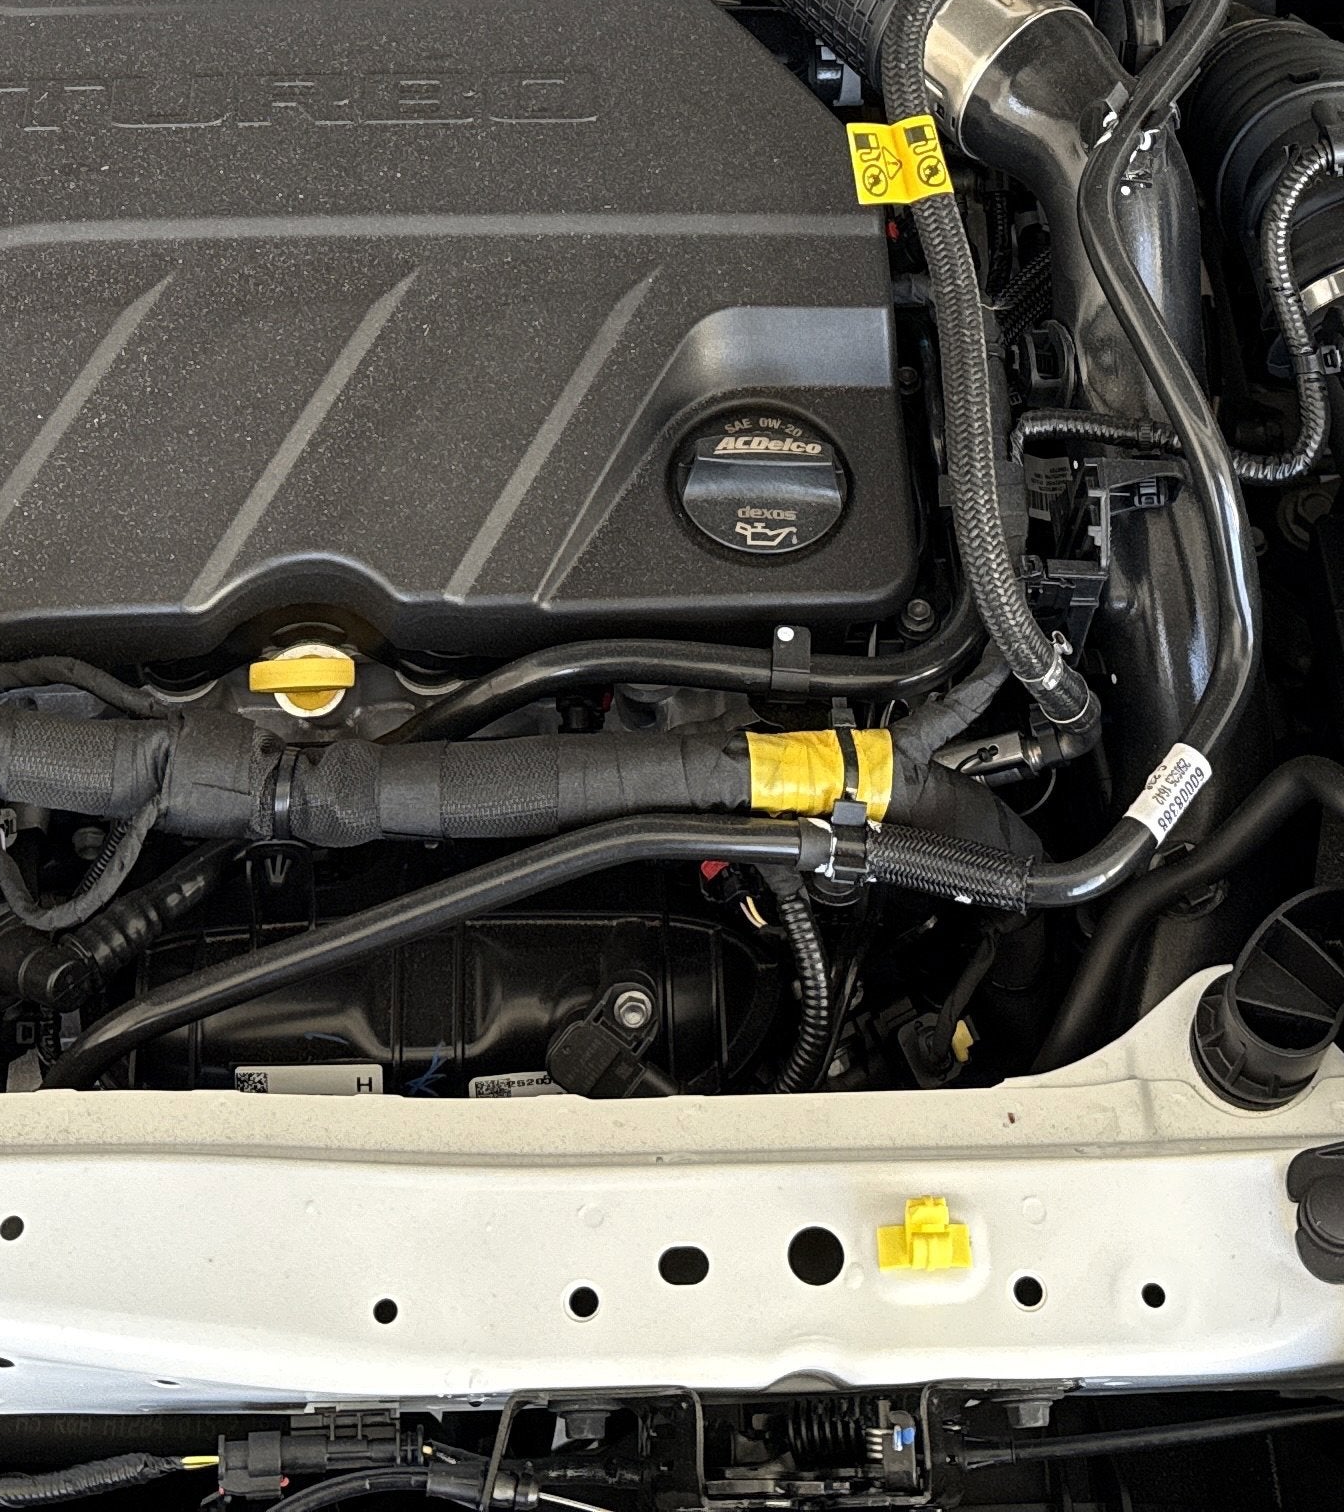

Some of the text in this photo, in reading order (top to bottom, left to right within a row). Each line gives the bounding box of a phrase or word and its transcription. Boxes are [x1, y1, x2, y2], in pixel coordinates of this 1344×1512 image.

[724, 417, 803, 438] SAE 0W-20
[714, 436, 823, 455] ACDelco
[737, 505, 799, 521] dexos
[356, 1076, 373, 1093] H
